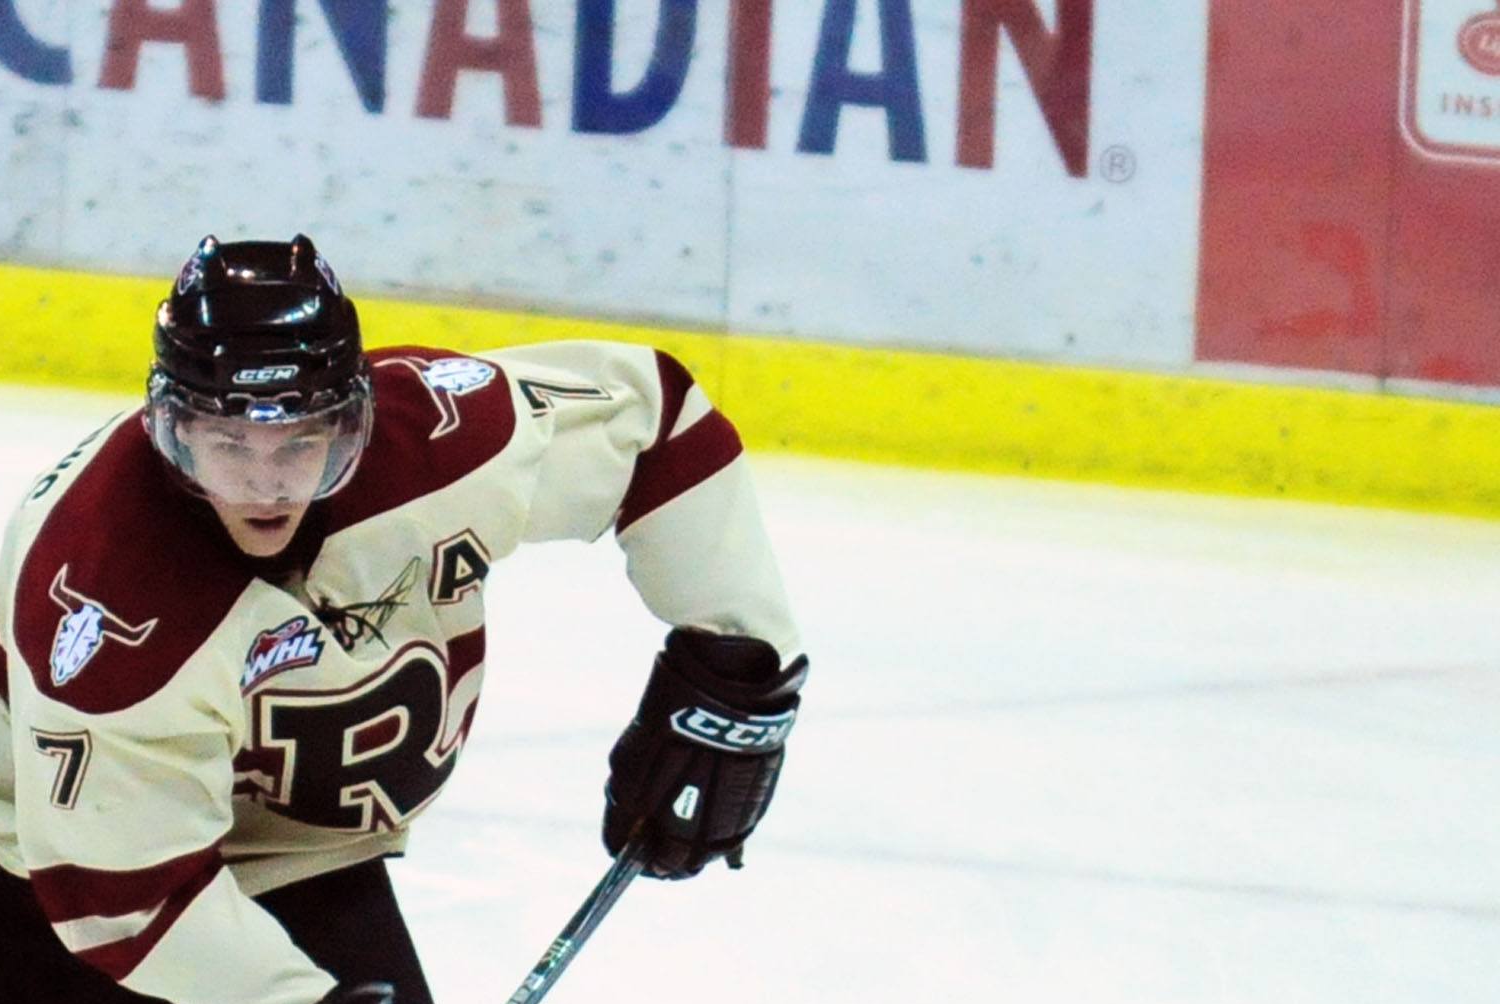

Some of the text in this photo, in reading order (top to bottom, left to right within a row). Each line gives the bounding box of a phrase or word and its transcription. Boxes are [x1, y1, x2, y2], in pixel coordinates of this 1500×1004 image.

[1441, 93, 1500, 118] INS
[236, 367, 296, 383] CCM
[517, 376, 613, 418] 7
[429, 527, 491, 606] A
[243, 630, 323, 688] WHL
[251, 639, 460, 833] R
[30, 726, 93, 811] 7
